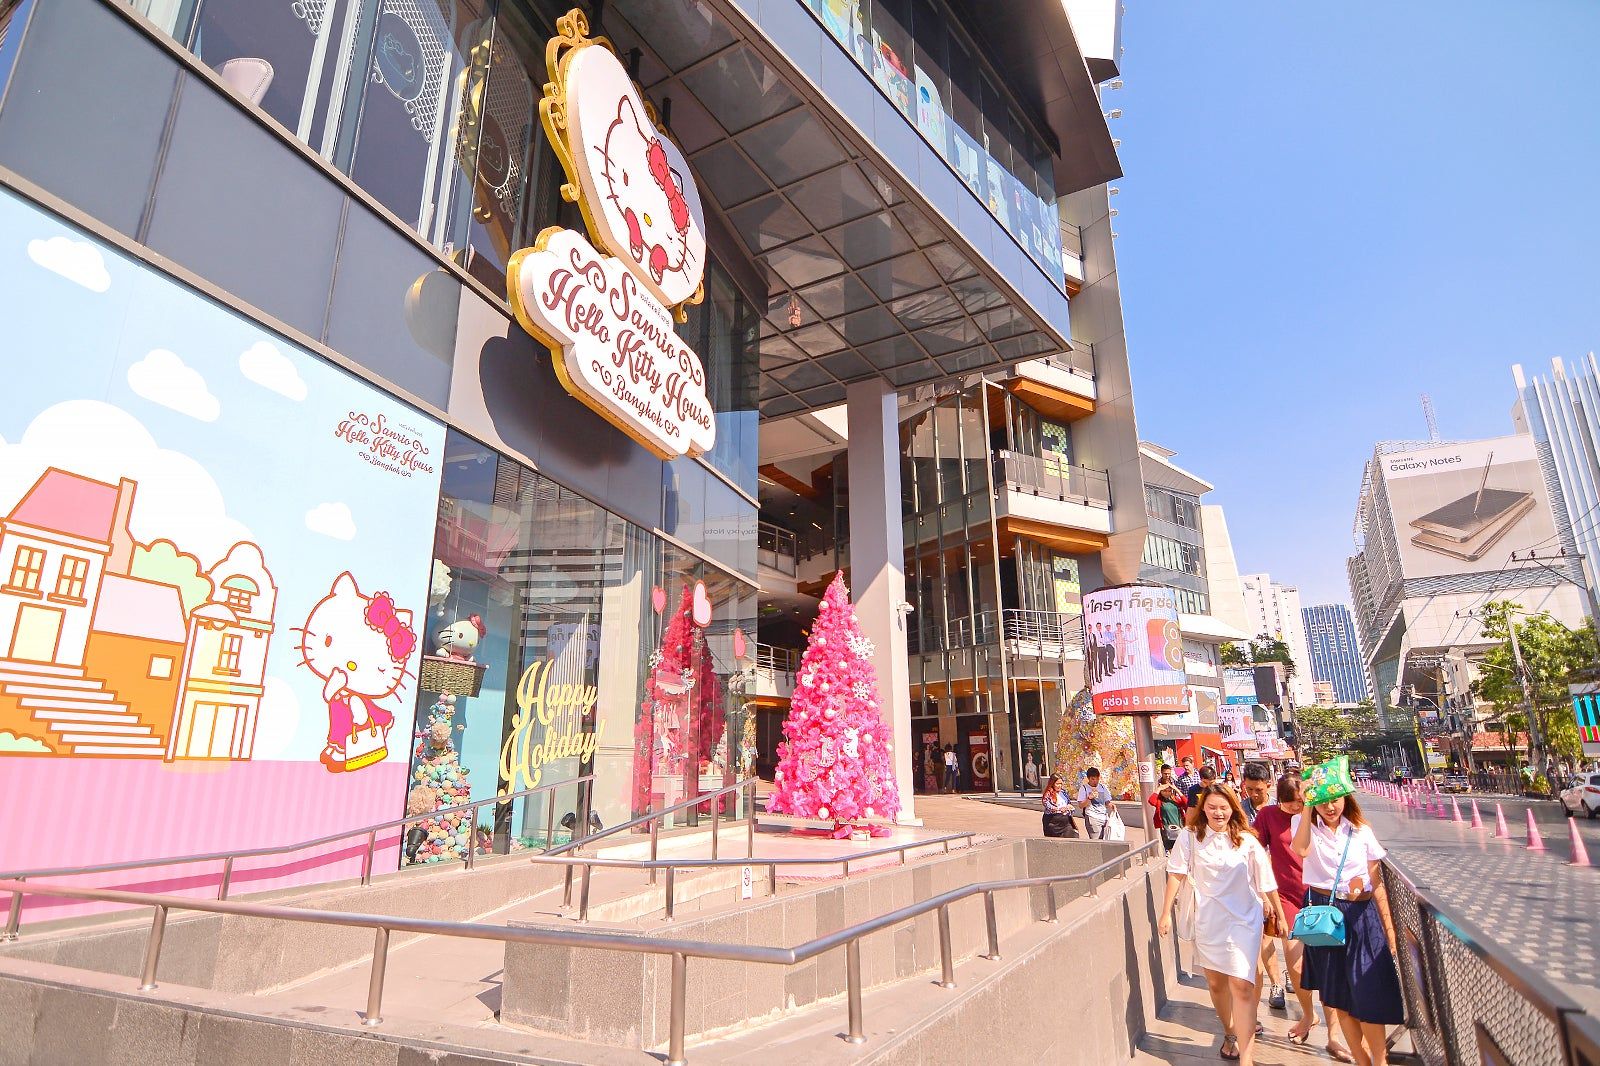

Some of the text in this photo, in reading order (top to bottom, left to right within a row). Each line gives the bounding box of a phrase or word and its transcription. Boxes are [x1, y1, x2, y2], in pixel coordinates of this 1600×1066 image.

[610, 271, 675, 359] Sanrio
[542, 268, 611, 344] Hello
[611, 329, 663, 395] Kitty
[662, 372, 711, 430] House
[612, 374, 664, 428] Bangkok
[334, 420, 370, 445] Hello
[369, 436, 401, 461] Kitty
[399, 449, 434, 474] House
[369, 413, 411, 446] Sanrio
[369, 455, 401, 475] Bangkok
[1390, 461, 1428, 472] Galaxy
[511, 658, 598, 728] Happy
[1102, 694, 1129, 711] ดูช่อง
[1132, 695, 1140, 706] 8
[498, 717, 606, 804] Holiday!
